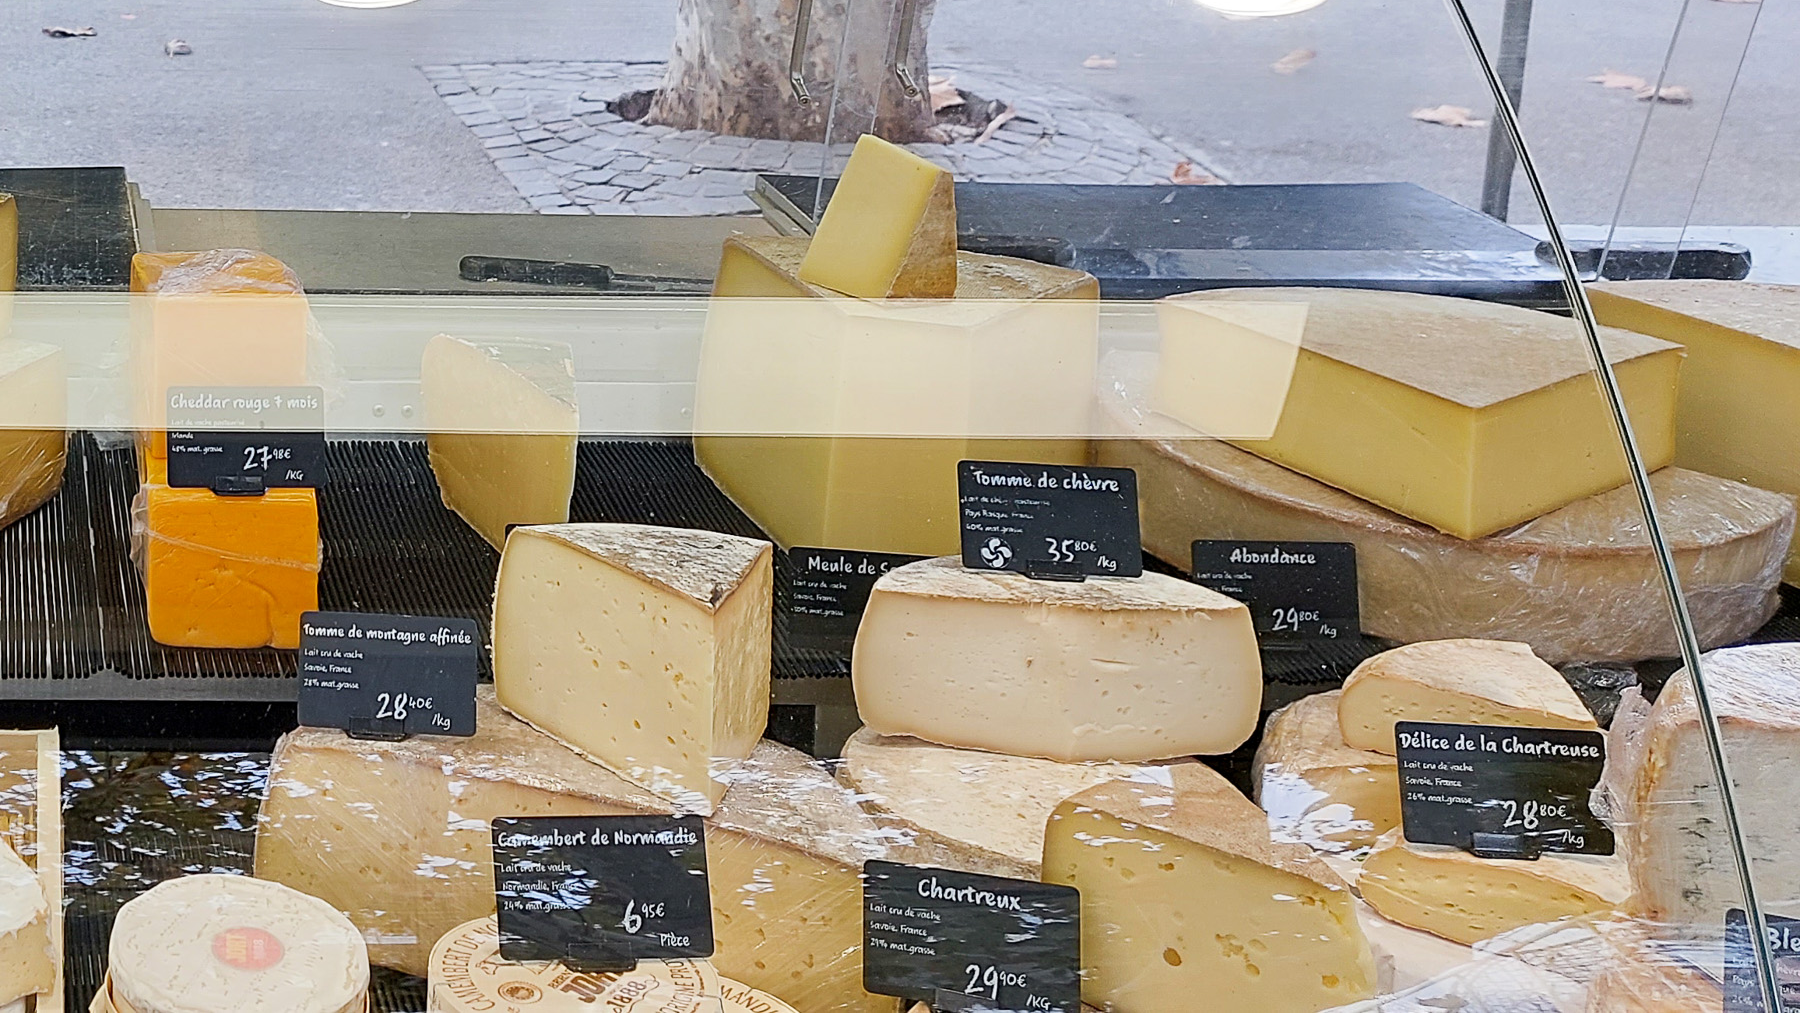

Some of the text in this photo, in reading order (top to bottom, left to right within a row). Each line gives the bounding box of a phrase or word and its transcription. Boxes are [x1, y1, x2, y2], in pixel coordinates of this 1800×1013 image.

[171, 393, 318, 413] Cheddar rouge 7 mois
[243, 446, 273, 471] 27
[285, 469, 304, 481] /KG
[973, 471, 1120, 492] Tomme de chèvre
[1045, 537, 1097, 562] 35 80€
[1229, 547, 1317, 565] Abondance
[808, 556, 853, 573] Meule
[858, 558, 876, 575] de
[1272, 607, 1320, 631] 29 80€
[303, 623, 472, 647] Tomme de montagne affinée
[304, 648, 319, 656] Lait
[333, 649, 342, 658] de
[329, 664, 352, 673] France
[376, 692, 433, 720] 28 40€
[432, 713, 451, 730] /kg
[1399, 731, 1600, 758] Délice de la Chartreuse
[1404, 761, 1421, 769] Lait
[1502, 800, 1567, 830] 28 80€
[498, 822, 699, 847] Camembert de Normandie
[917, 877, 1022, 911] Chartreux
[623, 899, 665, 934] 6 95€
[870, 902, 941, 921] Lait cru de vache
[660, 933, 690, 947] Pièce
[900, 924, 928, 936] France
[442, 934, 495, 1010] CAMEMBERT DE
[965, 964, 1027, 1001] 29 90€
[1026, 994, 1051, 1011] /KG
